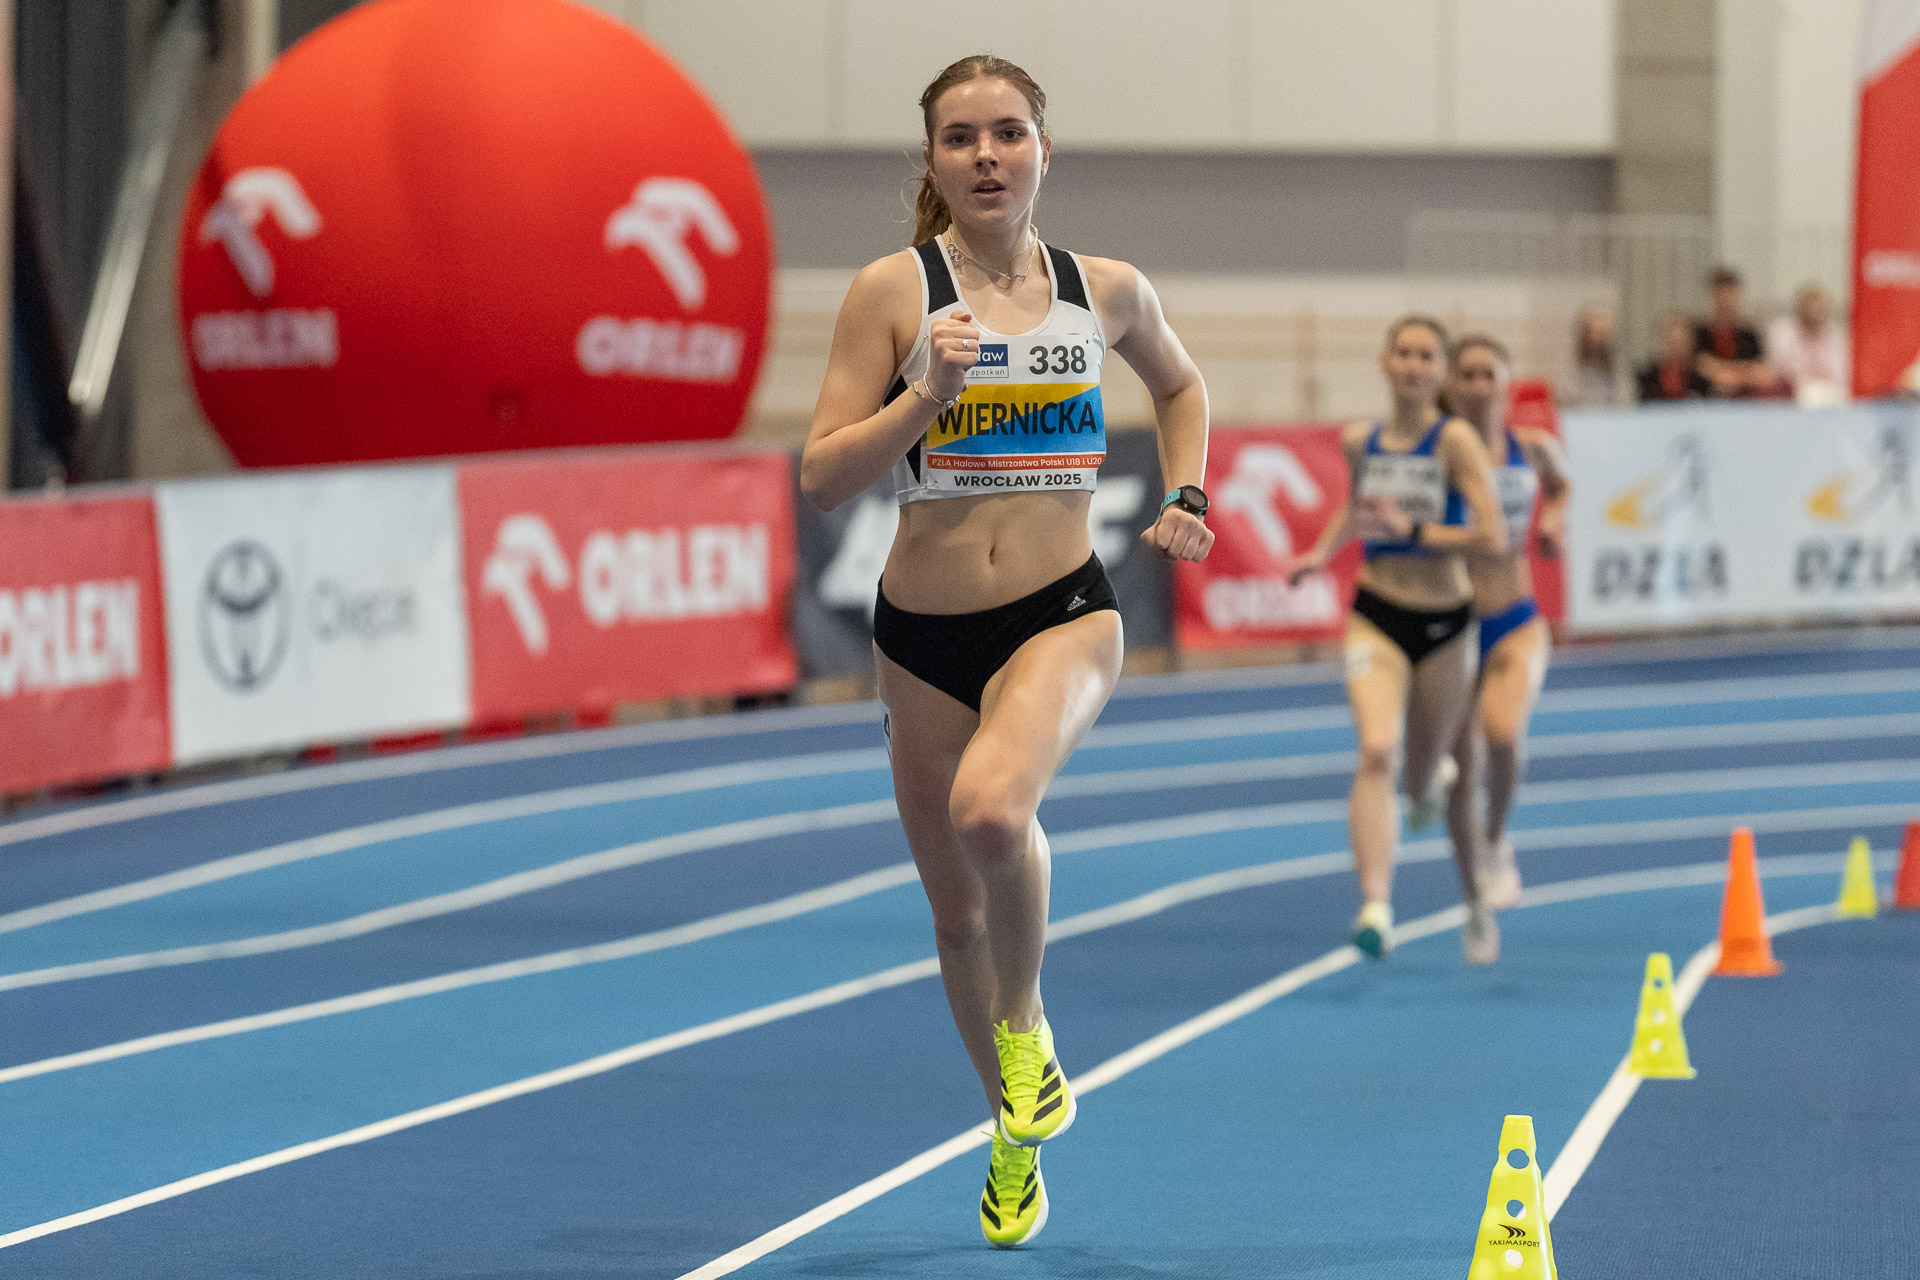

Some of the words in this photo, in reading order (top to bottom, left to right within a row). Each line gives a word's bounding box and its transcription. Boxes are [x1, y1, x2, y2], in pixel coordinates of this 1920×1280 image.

[1029, 345, 1087, 375] 338
[970, 368, 1005, 377] spotkań
[938, 402, 1098, 435] WIERNICKA
[932, 457, 951, 467] PZLA
[953, 459, 986, 468] Halowe
[988, 459, 1039, 468] Mistrzostwa
[1041, 458, 1065, 466] Polski
[1067, 457, 1081, 466] U18
[1087, 457, 1102, 466] U20
[954, 474, 1041, 487] WROCŁAW
[1044, 473, 1082, 486] 2025
[581, 525, 769, 626] ORLEN
[0, 579, 138, 697] ORLEN
[1488, 1239, 1540, 1247] YAKIMASPORT
